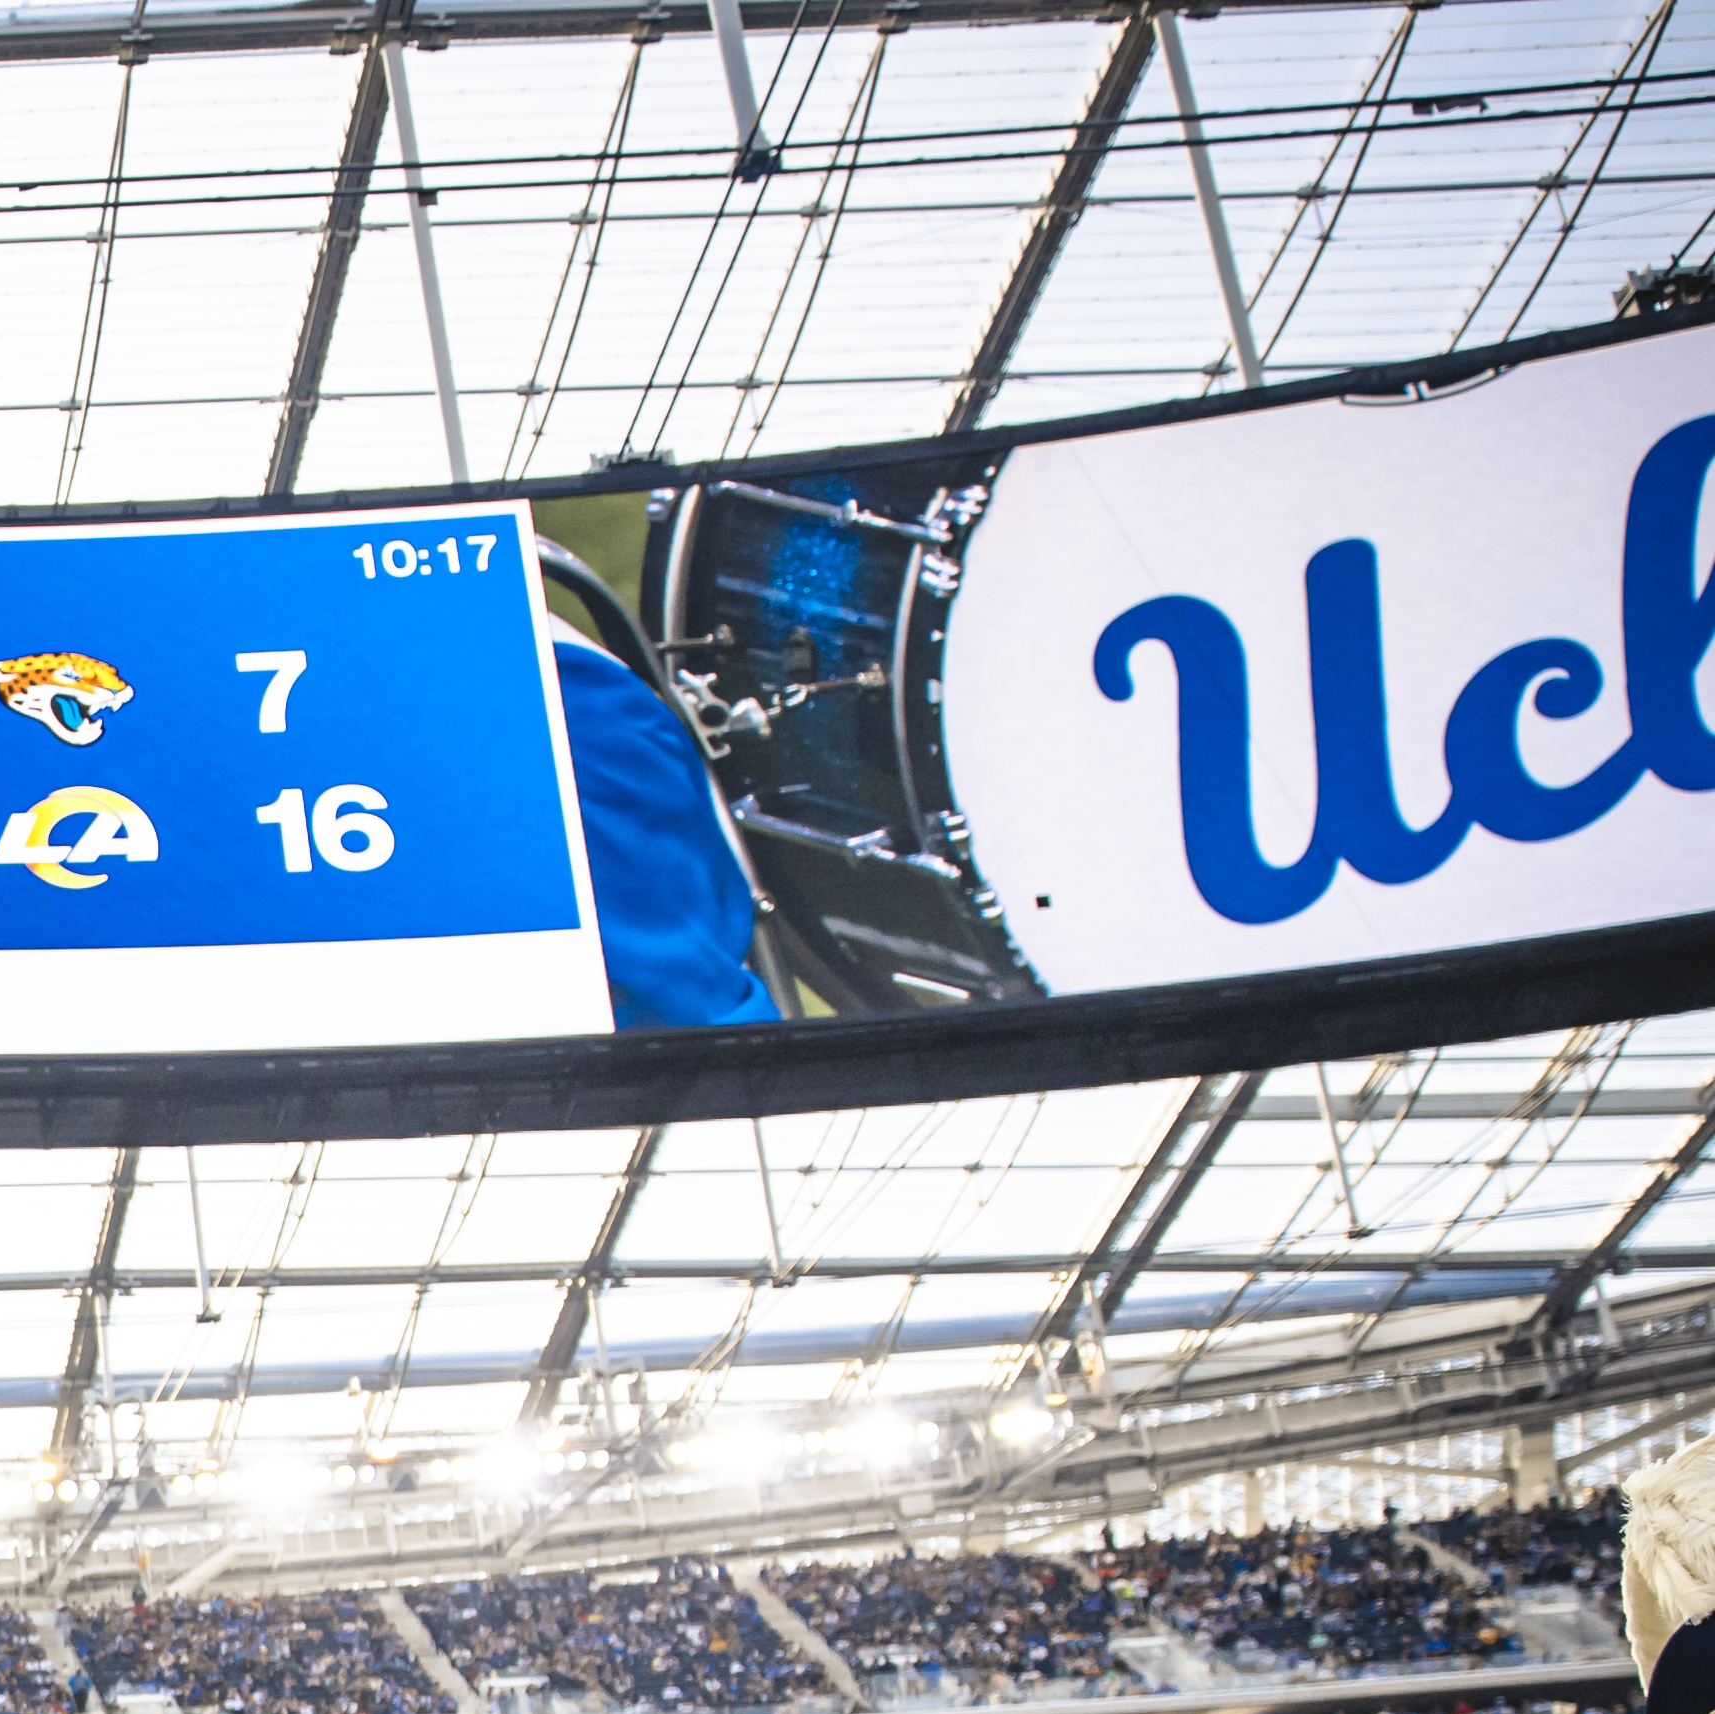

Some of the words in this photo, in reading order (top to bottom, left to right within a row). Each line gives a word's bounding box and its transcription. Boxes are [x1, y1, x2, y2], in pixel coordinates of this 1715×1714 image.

[352, 533, 498, 580] 10:17
[235, 650, 308, 733] 7
[255, 783, 395, 874] 16
